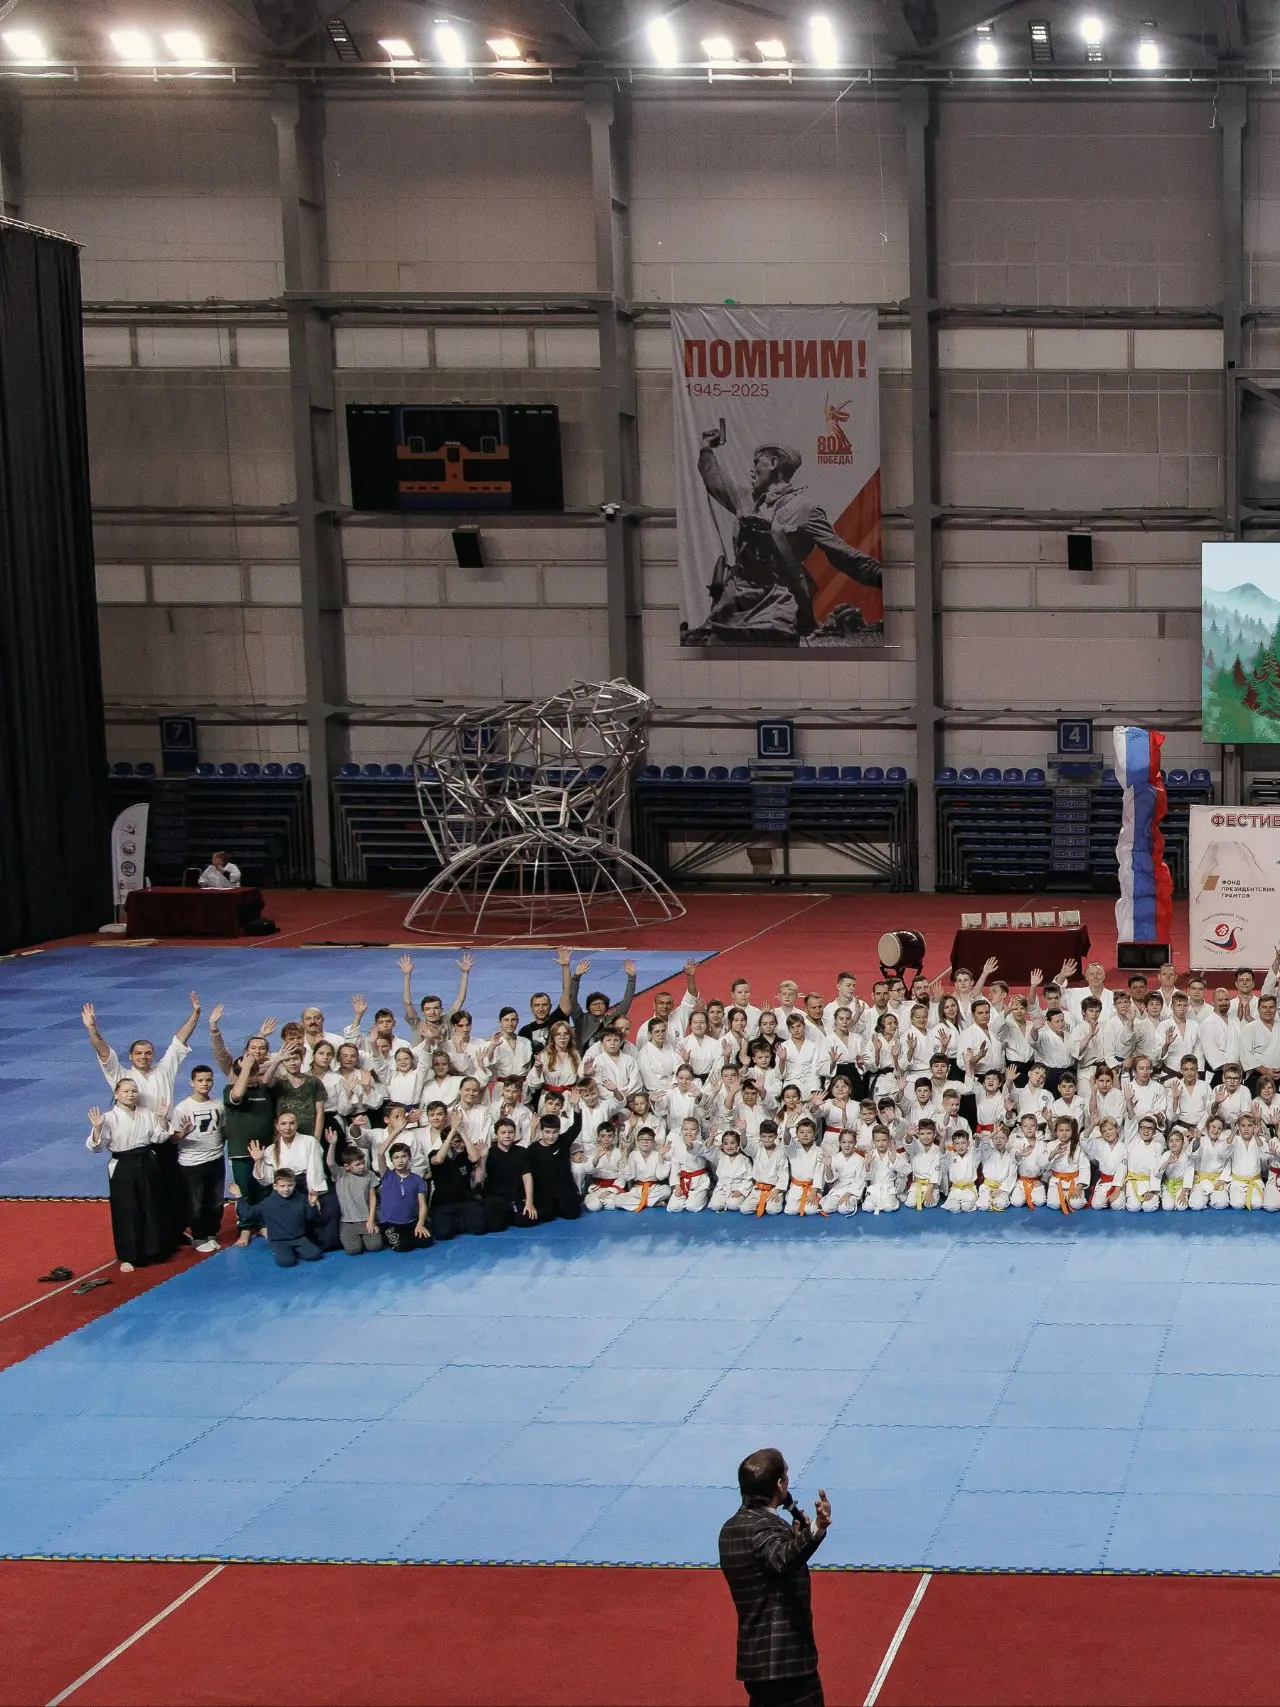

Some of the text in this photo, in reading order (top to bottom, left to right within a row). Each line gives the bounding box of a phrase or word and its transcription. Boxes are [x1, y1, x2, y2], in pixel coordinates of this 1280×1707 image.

[684, 340, 867, 378] ПОМНИМ!
[817, 456, 853, 464] ПОБЕДА!
[172, 724, 183, 739] 7
[771, 729, 779, 747] 1
[1069, 726, 1081, 743] 4
